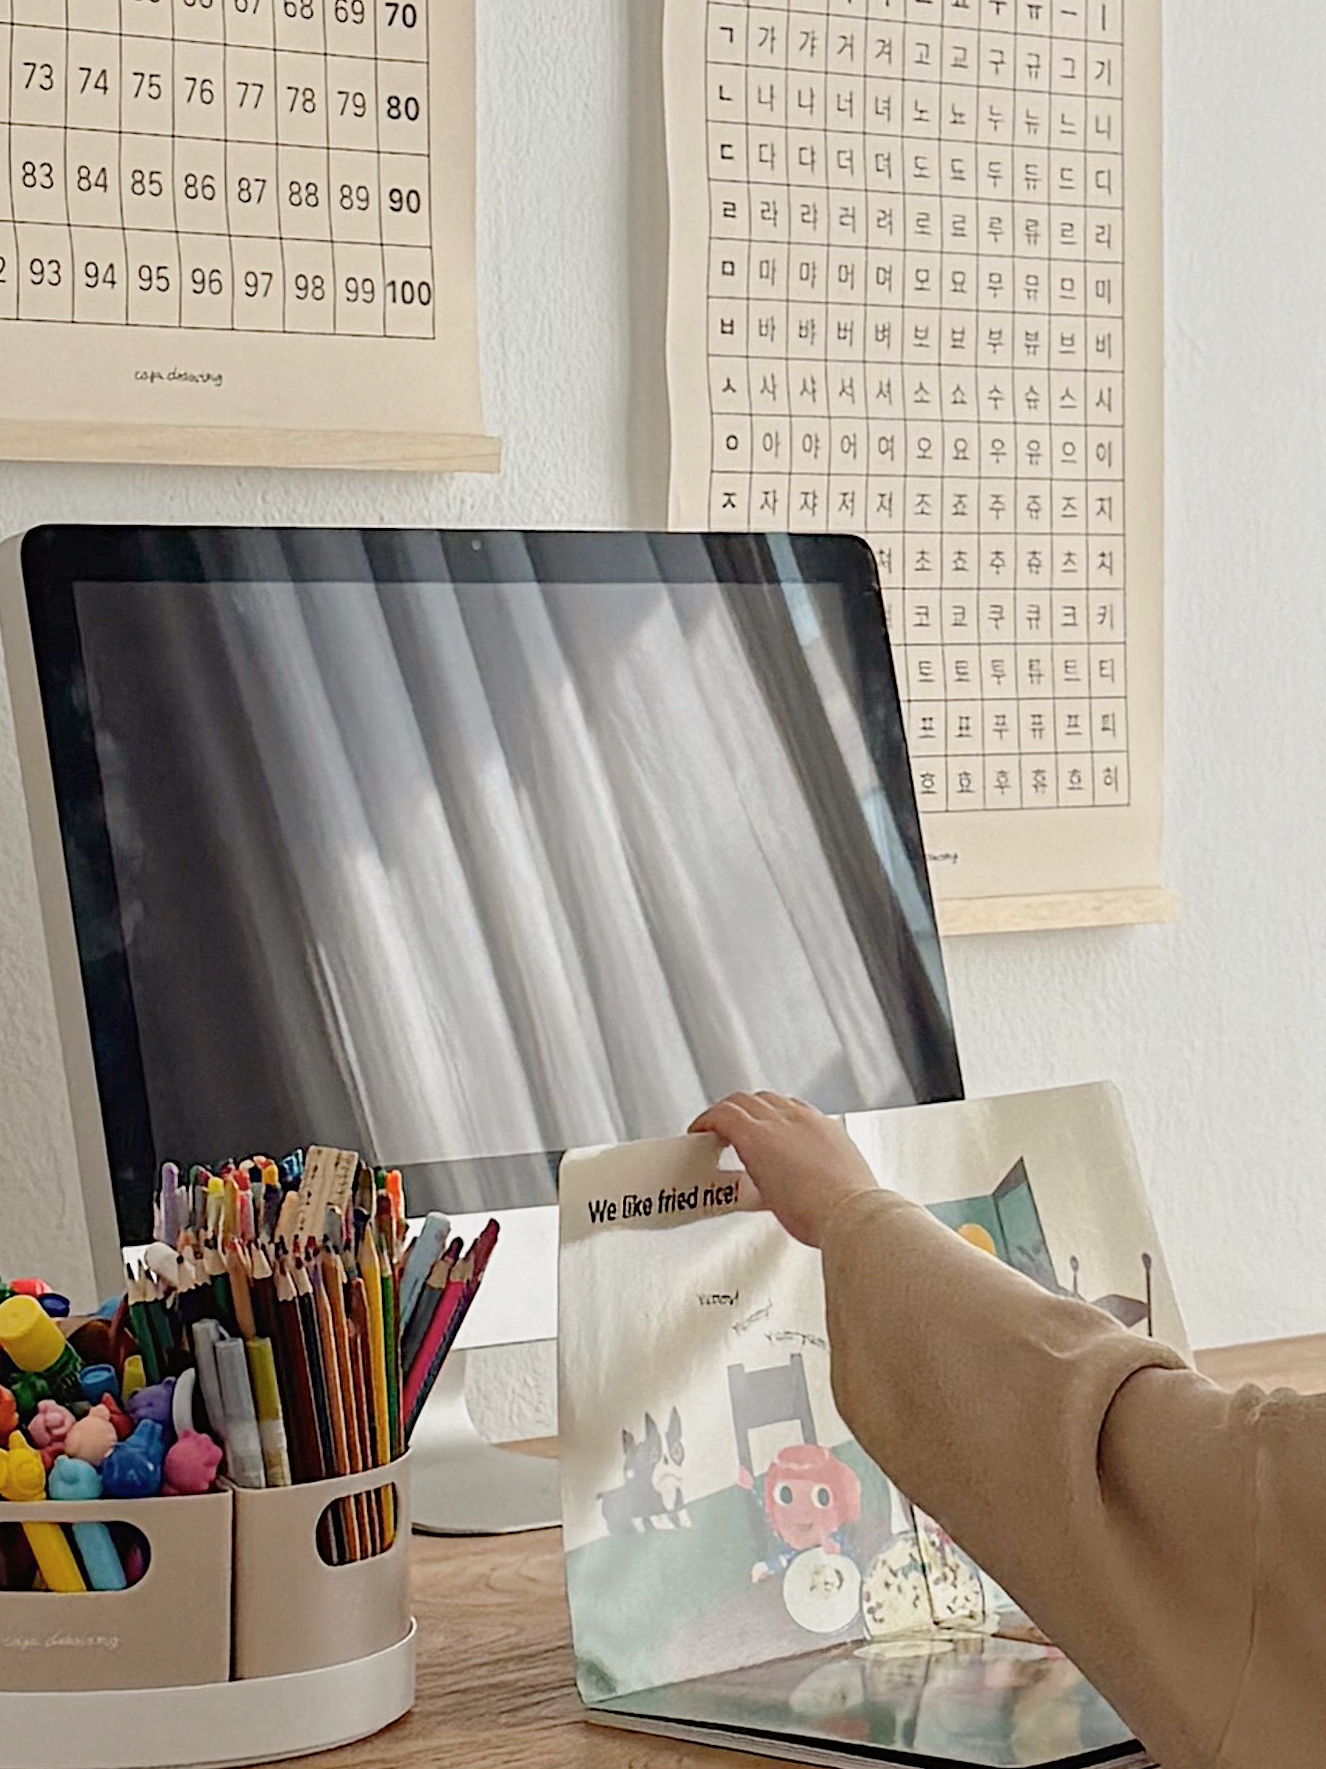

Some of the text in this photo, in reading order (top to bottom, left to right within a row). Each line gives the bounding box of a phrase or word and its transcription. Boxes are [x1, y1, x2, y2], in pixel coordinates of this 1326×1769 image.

[757, 25, 777, 55] 가
[798, 29, 819, 58] 갸
[836, 33, 855, 63] 거
[874, 37, 893, 66] 겨
[913, 41, 932, 66] 고
[988, 48, 1007, 76] 구
[1025, 52, 1042, 80] 규
[1059, 56, 1077, 80] 그
[1094, 58, 1112, 87] 기
[22, 61, 54, 92] 73
[78, 66, 109, 96] 74
[131, 71, 162, 101] 75
[183, 76, 215, 106] 76
[236, 81, 265, 110] 77
[286, 85, 317, 114] 78
[336, 90, 367, 119] 79
[386, 94, 421, 122] 80
[757, 83, 776, 113] 나
[836, 90, 854, 120] 너
[874, 94, 892, 124] 녀
[912, 98, 931, 123] 노
[987, 104, 1005, 132] 누
[1023, 108, 1041, 135] 뉴
[1059, 112, 1078, 136] 느
[1094, 114, 1112, 141] 니
[29, 257, 62, 287] 93
[84, 260, 117, 290] 94
[137, 264, 171, 293] 95
[190, 267, 224, 296] 96
[243, 270, 274, 298] 97
[294, 273, 326, 302] 98
[344, 276, 376, 305] 99
[385, 277, 433, 308] 100
[759, 372, 778, 402] 사
[799, 374, 818, 404] 샤
[838, 376, 856, 405] 서
[875, 377, 893, 406] 셔
[912, 380, 932, 404] 소
[950, 383, 968, 406] 쇼
[986, 384, 1006, 411] 수
[1024, 384, 1041, 411] 슈
[1059, 386, 1078, 410] 스
[1094, 386, 1113, 414] 시
[761, 429, 781, 459] 아
[801, 432, 822, 460] 야
[839, 432, 858, 461] 어
[877, 434, 895, 463] 여
[915, 436, 934, 460] 오
[951, 437, 971, 461] 요
[989, 437, 1008, 465] 우
[1025, 438, 1043, 466] 유
[1060, 440, 1078, 465] 으
[1095, 440, 1113, 469] 이
[587, 1179, 740, 1225] We like fried rice!
